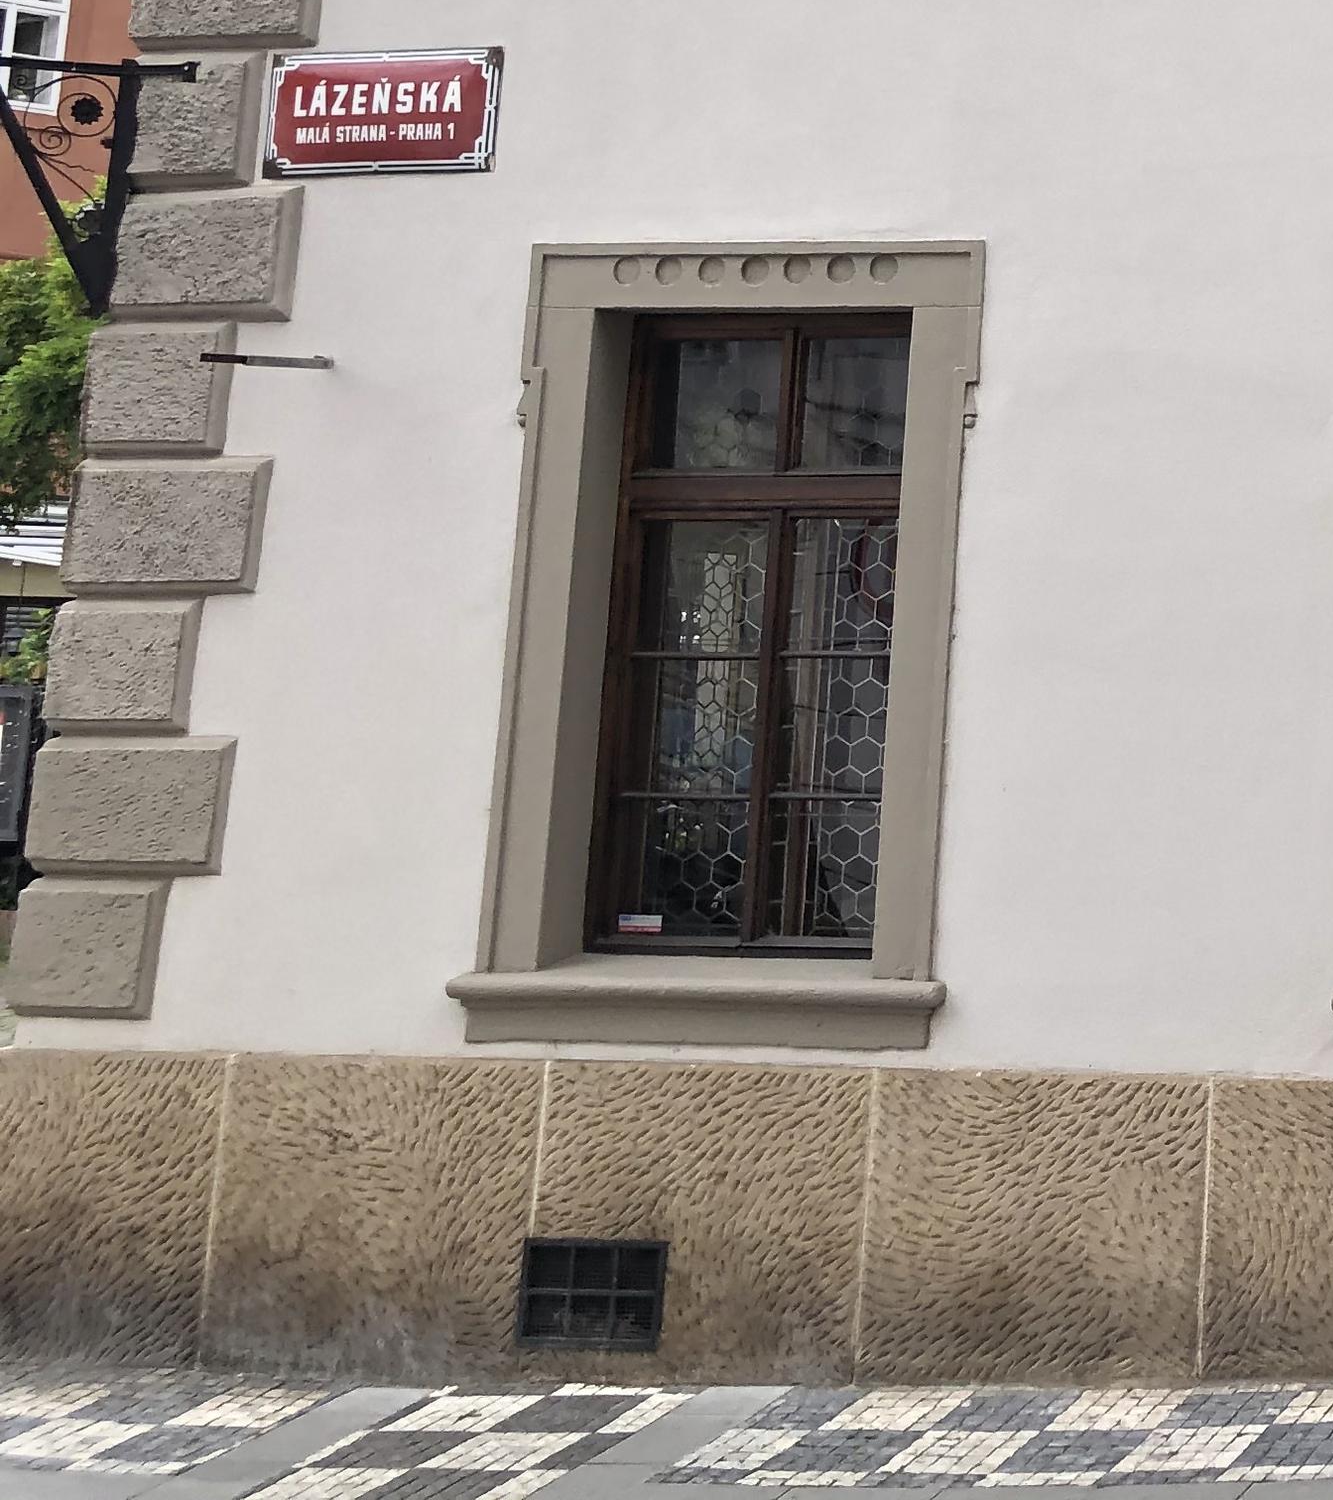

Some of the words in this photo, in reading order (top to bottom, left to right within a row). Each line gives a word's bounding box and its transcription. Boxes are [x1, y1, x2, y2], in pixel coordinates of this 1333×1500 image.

[293, 75, 463, 117] LÁZEŇSKÁ
[296, 122, 331, 144] MALÁ
[336, 124, 387, 143] STRANA
[399, 122, 442, 141] PRAHA
[447, 122, 455, 140] 1
